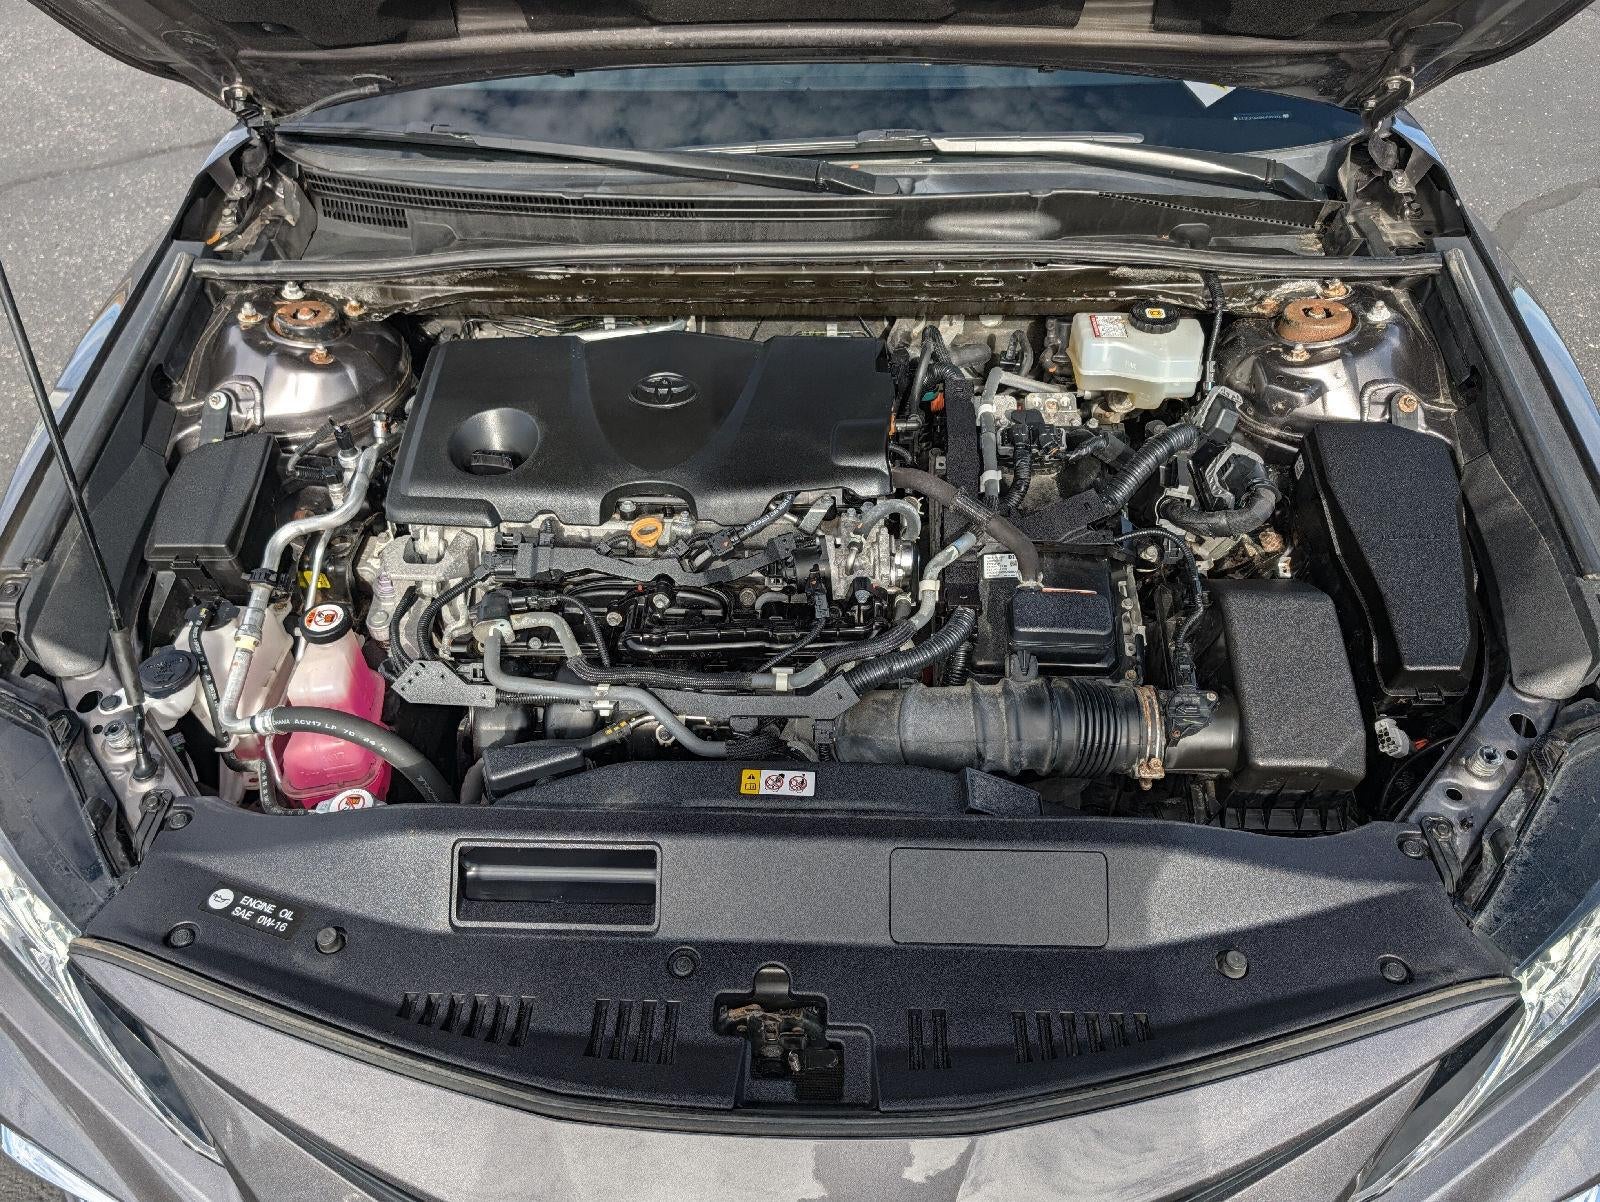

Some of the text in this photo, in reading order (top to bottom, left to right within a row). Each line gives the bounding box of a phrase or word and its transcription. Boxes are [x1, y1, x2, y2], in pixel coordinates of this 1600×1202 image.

[231, 907, 288, 931] SAE 0W-16
[240, 896, 293, 920] ENGINE OIL
